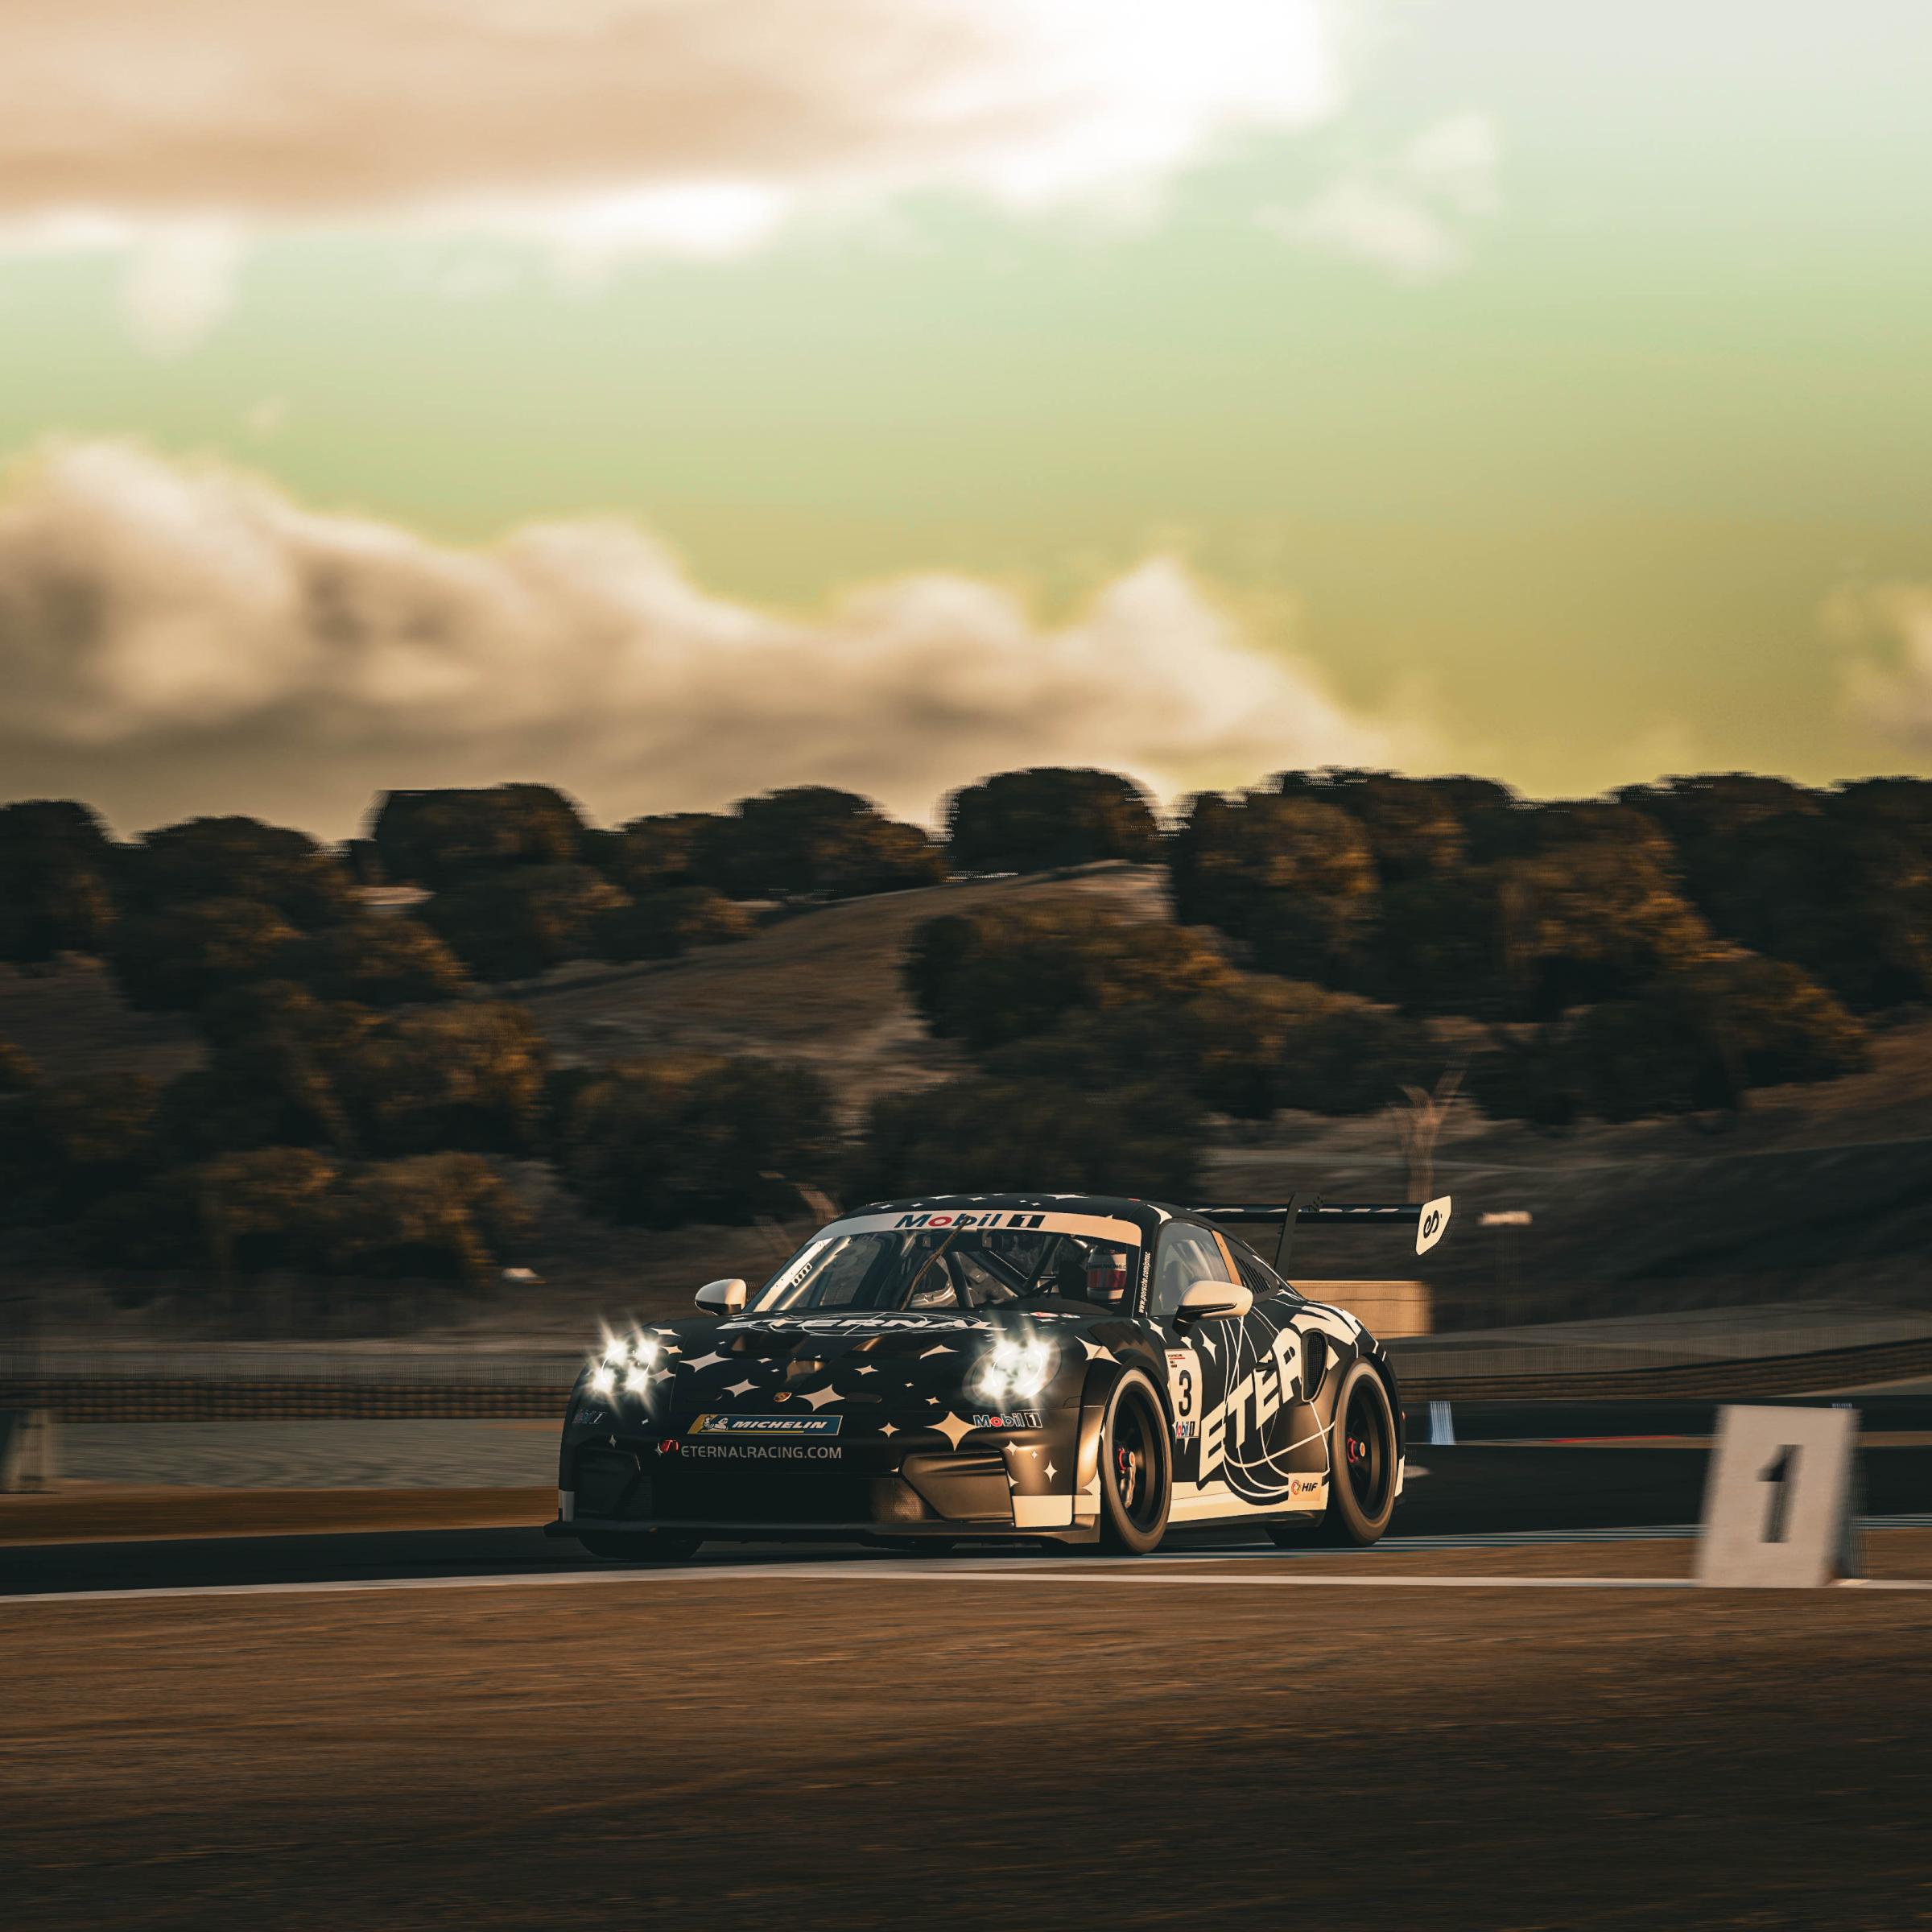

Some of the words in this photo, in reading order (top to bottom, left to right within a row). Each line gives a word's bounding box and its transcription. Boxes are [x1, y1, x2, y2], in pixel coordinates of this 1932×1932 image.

[894, 1213, 1003, 1228] Mobil
[716, 1319, 1008, 1331] ETERNAL
[1179, 1370, 1192, 1417] 3
[732, 1420, 828, 1429] MICHELIN
[972, 1413, 1026, 1427] Mobil
[681, 1445, 842, 1459] ETERNALRACING.COM
[1301, 1482, 1319, 1492] HIF
[1757, 1443, 1803, 1544] 1
